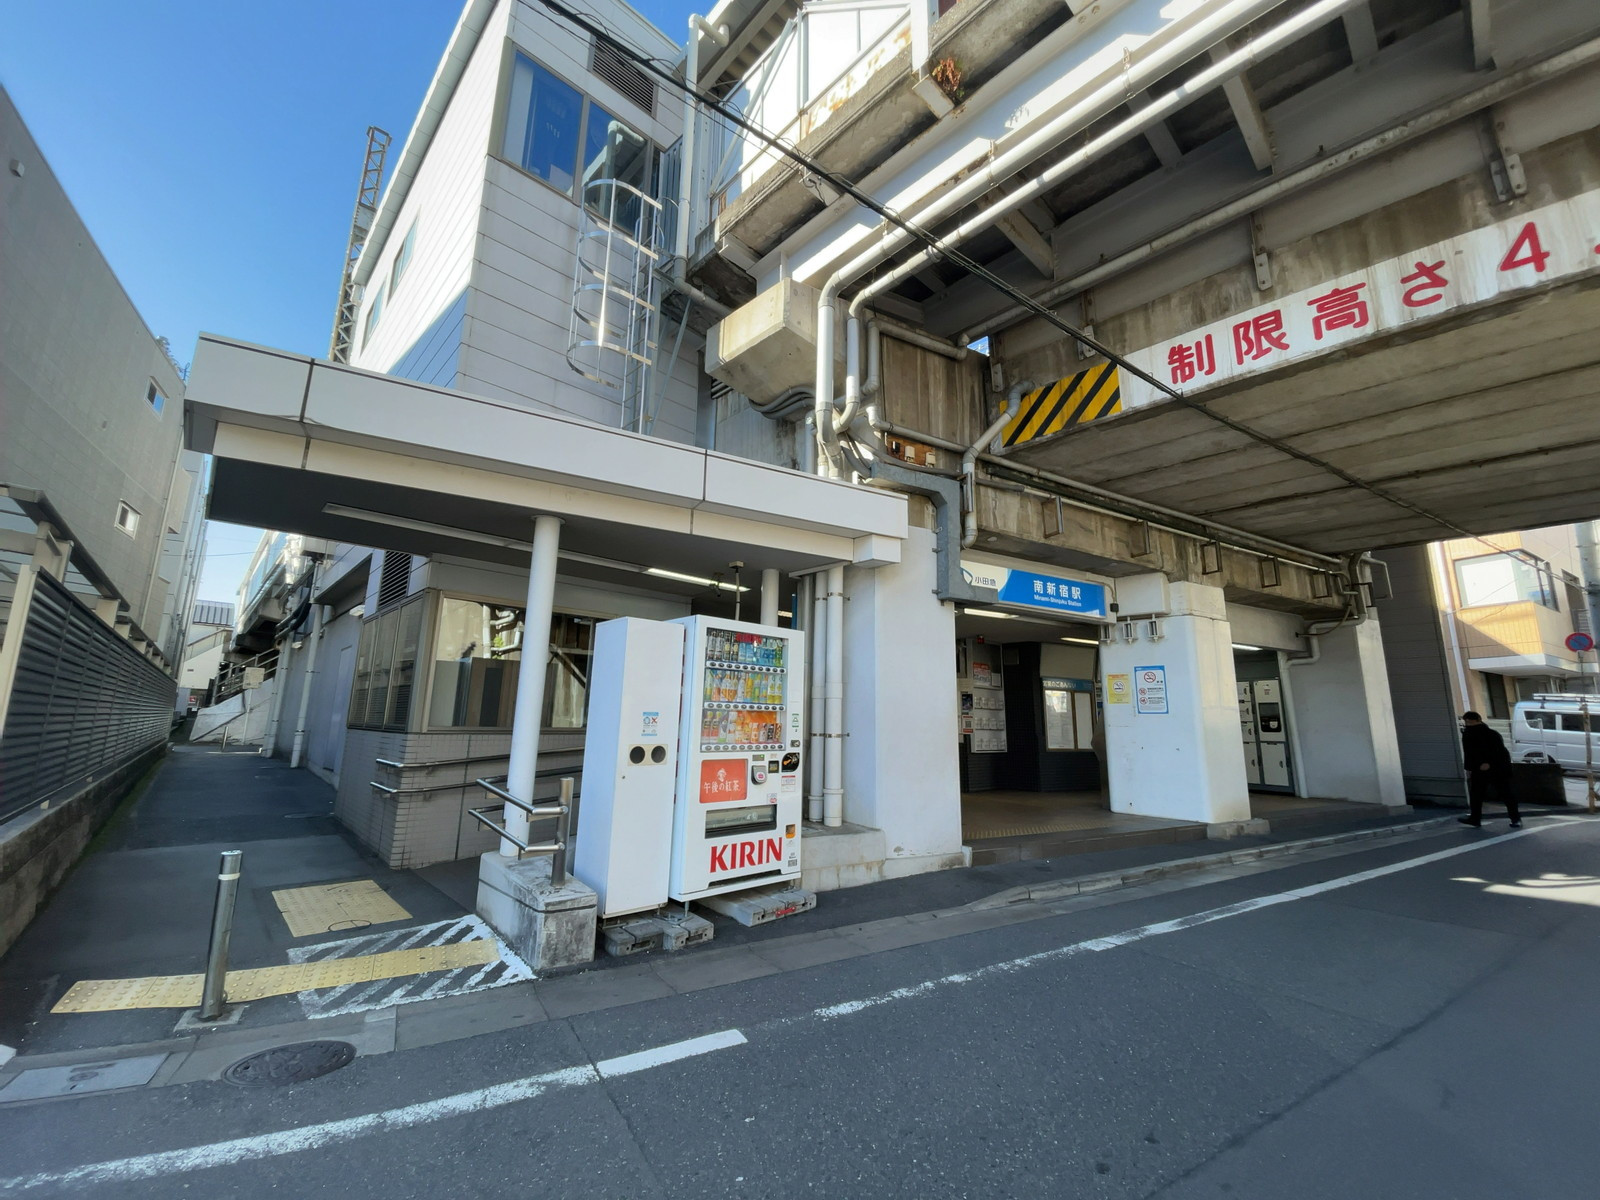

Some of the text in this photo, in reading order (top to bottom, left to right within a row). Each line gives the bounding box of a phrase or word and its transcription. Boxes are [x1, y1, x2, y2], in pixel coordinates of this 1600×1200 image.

[974, 576, 997, 587] 小田急
[1033, 580, 1082, 600] 南新宿駅
[1033, 594, 1082, 607] Minami-Shinjuku Station
[703, 780, 740, 794] 午後の紅茶
[710, 837, 783, 873] KIRIN
